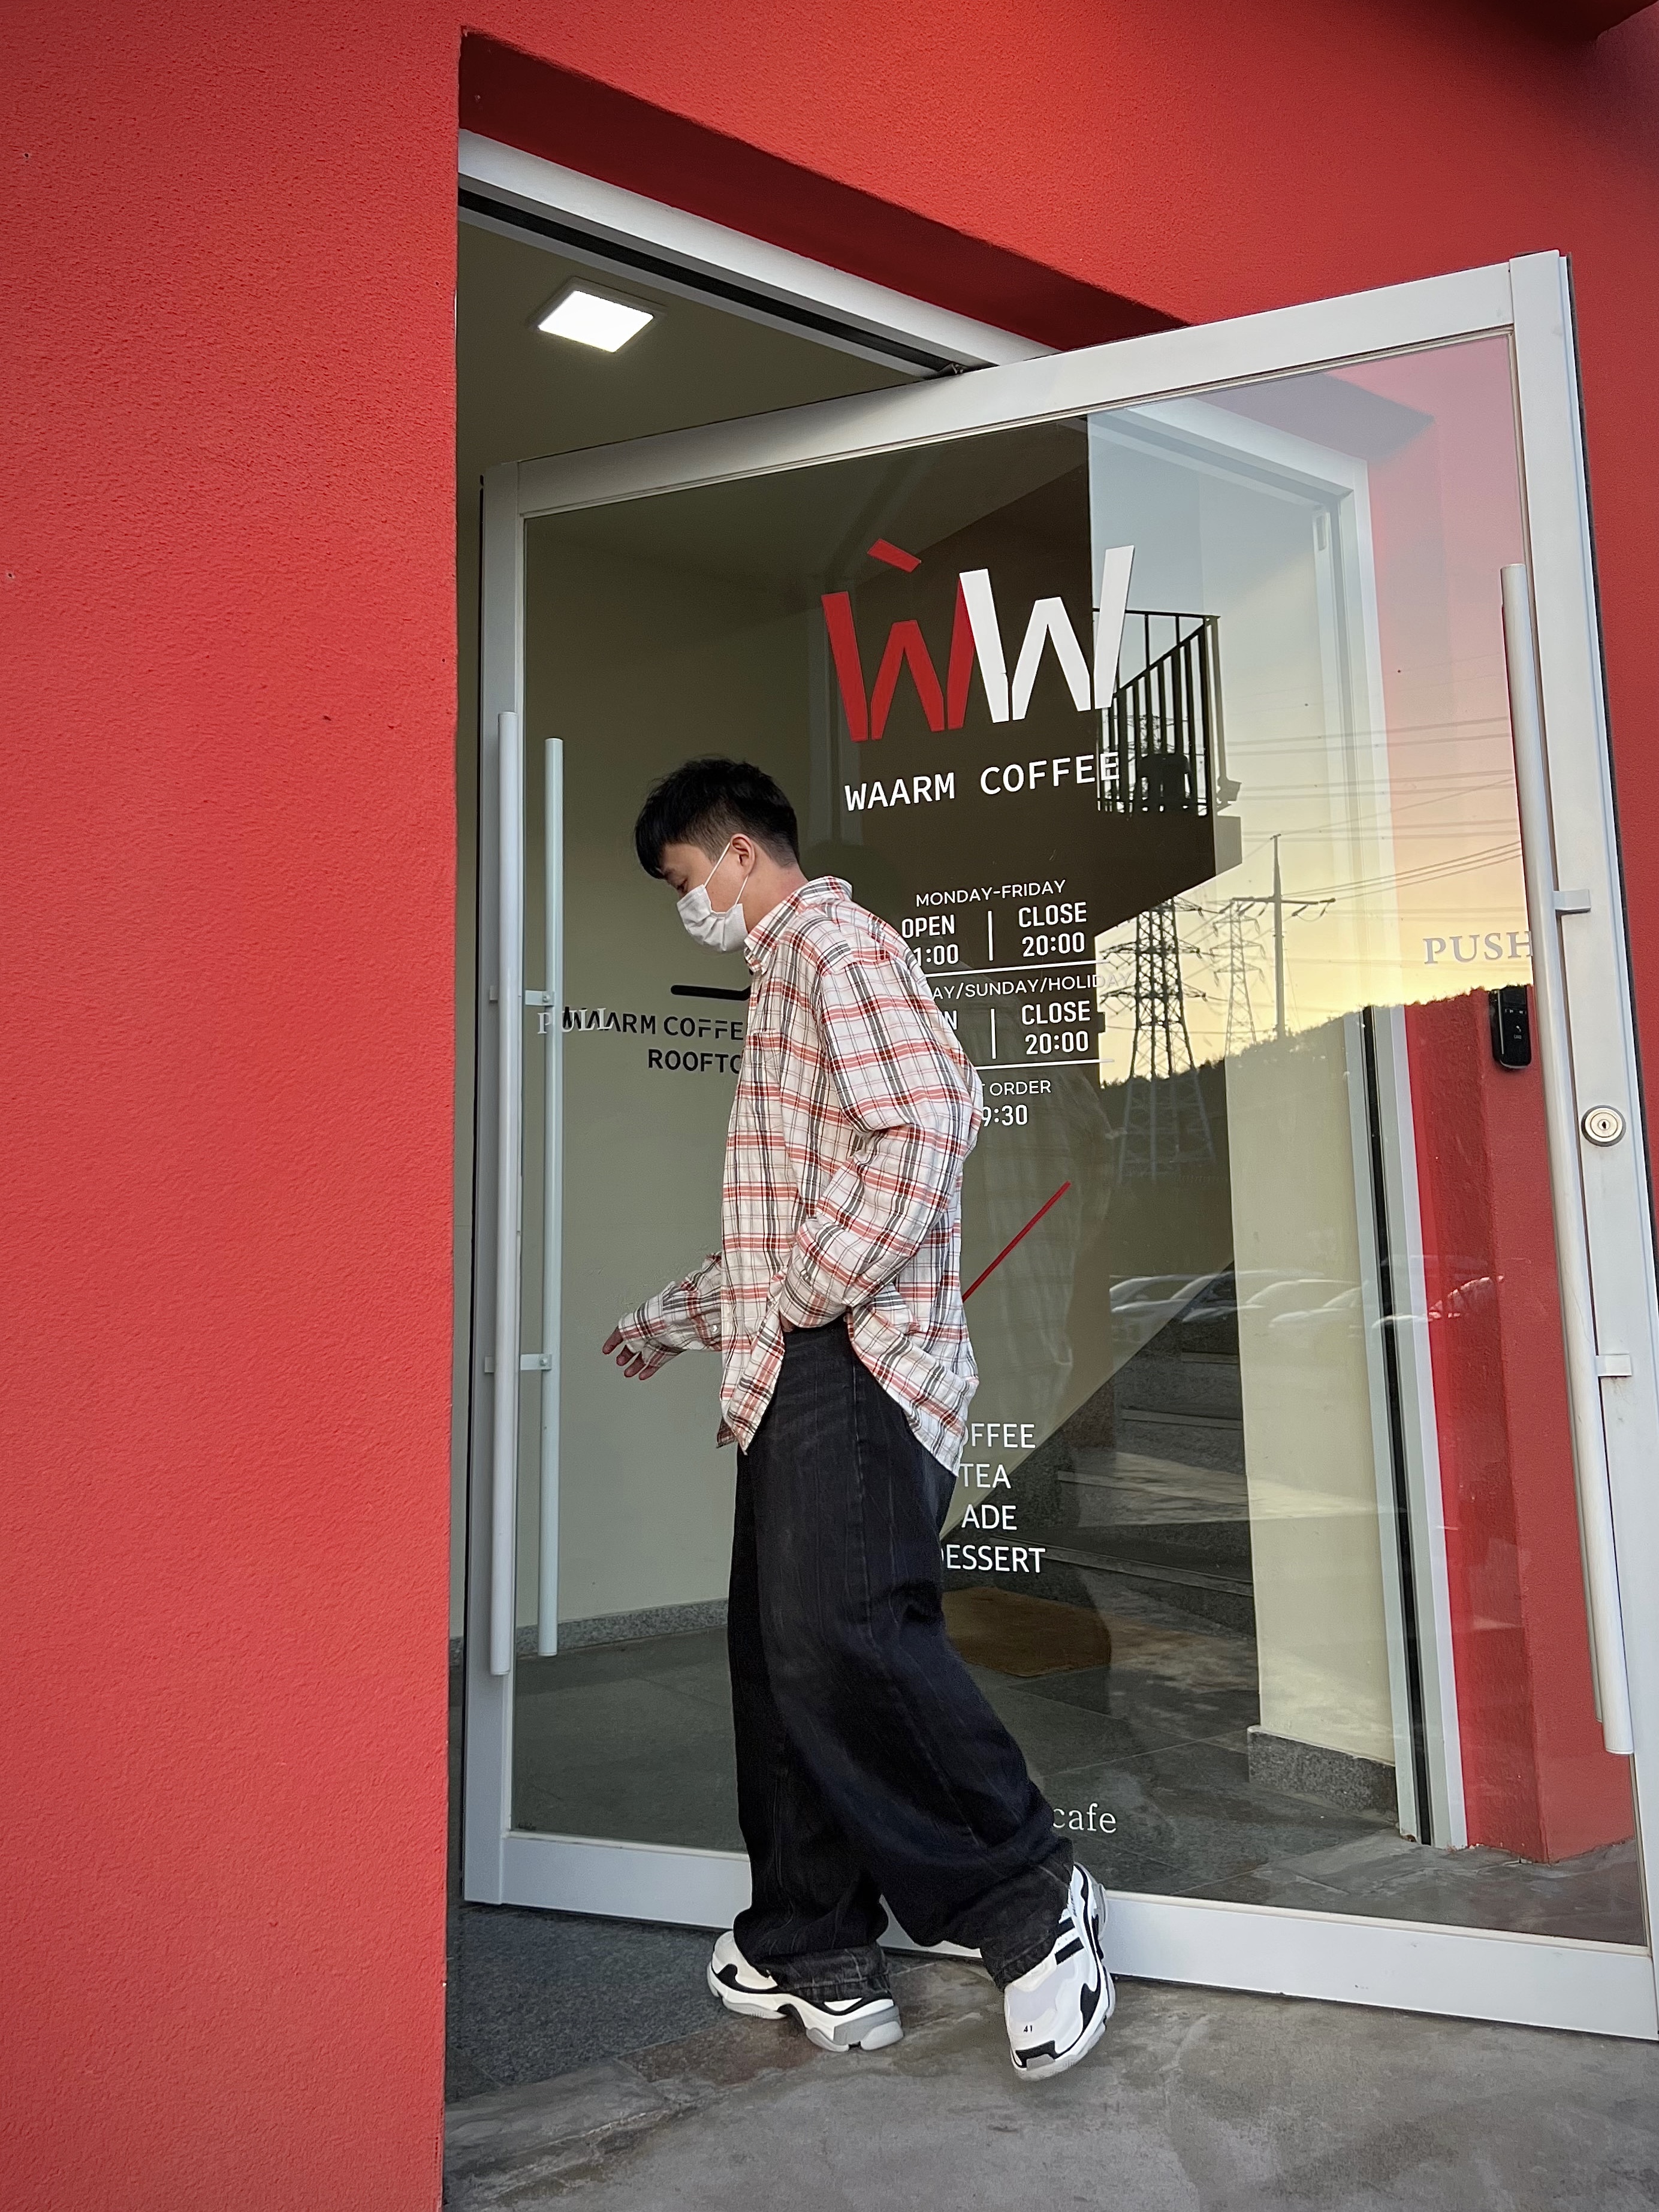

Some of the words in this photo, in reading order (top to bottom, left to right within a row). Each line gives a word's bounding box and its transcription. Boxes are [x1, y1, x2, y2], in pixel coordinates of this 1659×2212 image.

[844, 772, 955, 811] WAARM
[980, 752, 1120, 795] COFFEE
[916, 879, 1066, 907] MONDAY-FRIDAY
[901, 914, 955, 938] OPEN
[1018, 902, 1087, 928] CLOSE
[913, 944, 959, 967] 1:00
[1022, 932, 1085, 958] 20:00
[1422, 930, 1534, 964] PUSH
[537, 1007, 614, 1034] PULL
[1021, 1000, 1091, 1025] CLOSE
[663, 1016, 744, 1040] COFFE
[1025, 1031, 1089, 1055] 20:00
[648, 1049, 742, 1075] ROOFTO
[990, 1080, 1052, 1097] ORDER
[982, 1104, 1028, 1127] 9:30
[970, 1423, 1036, 1448] FFEE
[960, 1463, 1012, 1489] TEA
[961, 1504, 1018, 1531] ADE
[940, 1544, 1046, 1573] ESSERT
[1052, 1803, 1117, 1834] cafe
